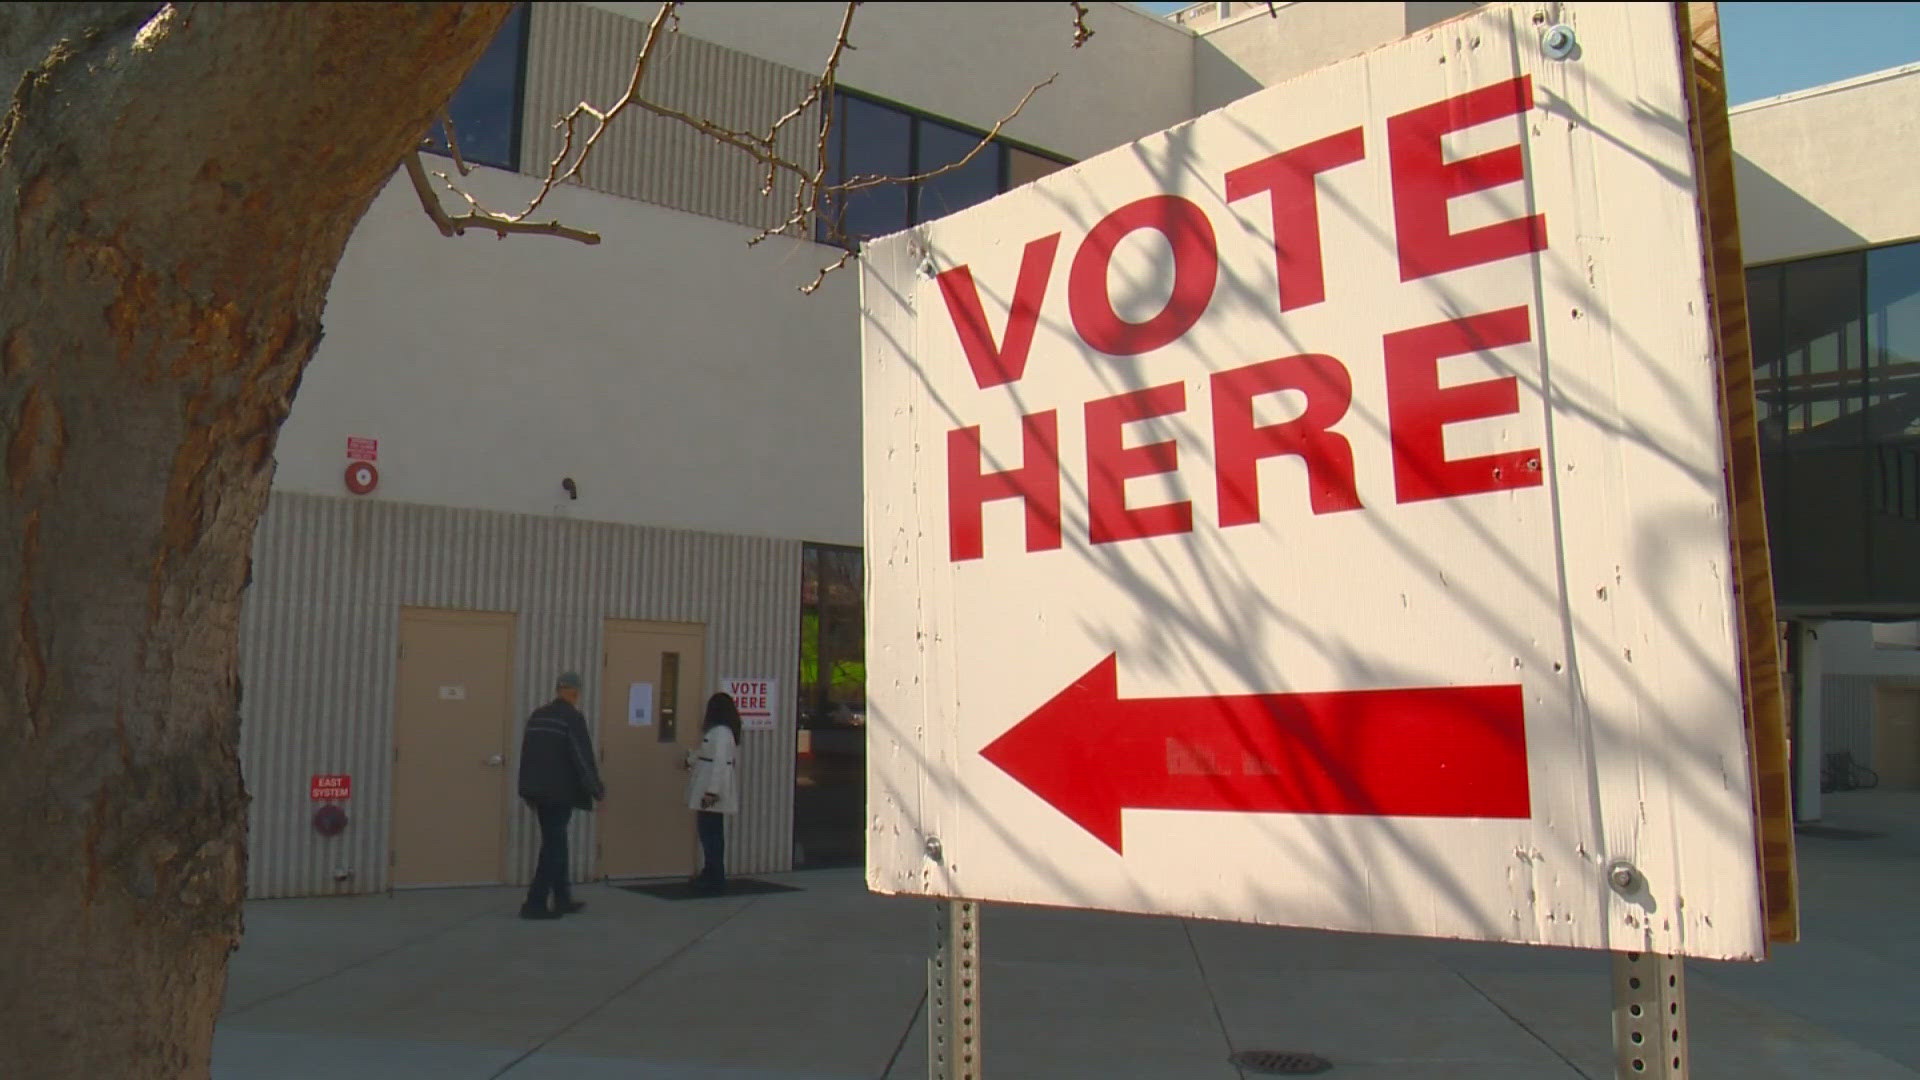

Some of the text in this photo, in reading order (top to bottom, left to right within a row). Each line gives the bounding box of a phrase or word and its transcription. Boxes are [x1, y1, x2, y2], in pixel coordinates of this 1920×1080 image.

[936, 74, 1549, 390] VOTE
[947, 304, 1544, 563] HERE
[731, 682, 768, 695] VOTE
[319, 778, 342, 787] EAST
[312, 788, 349, 798] SYSTEM
